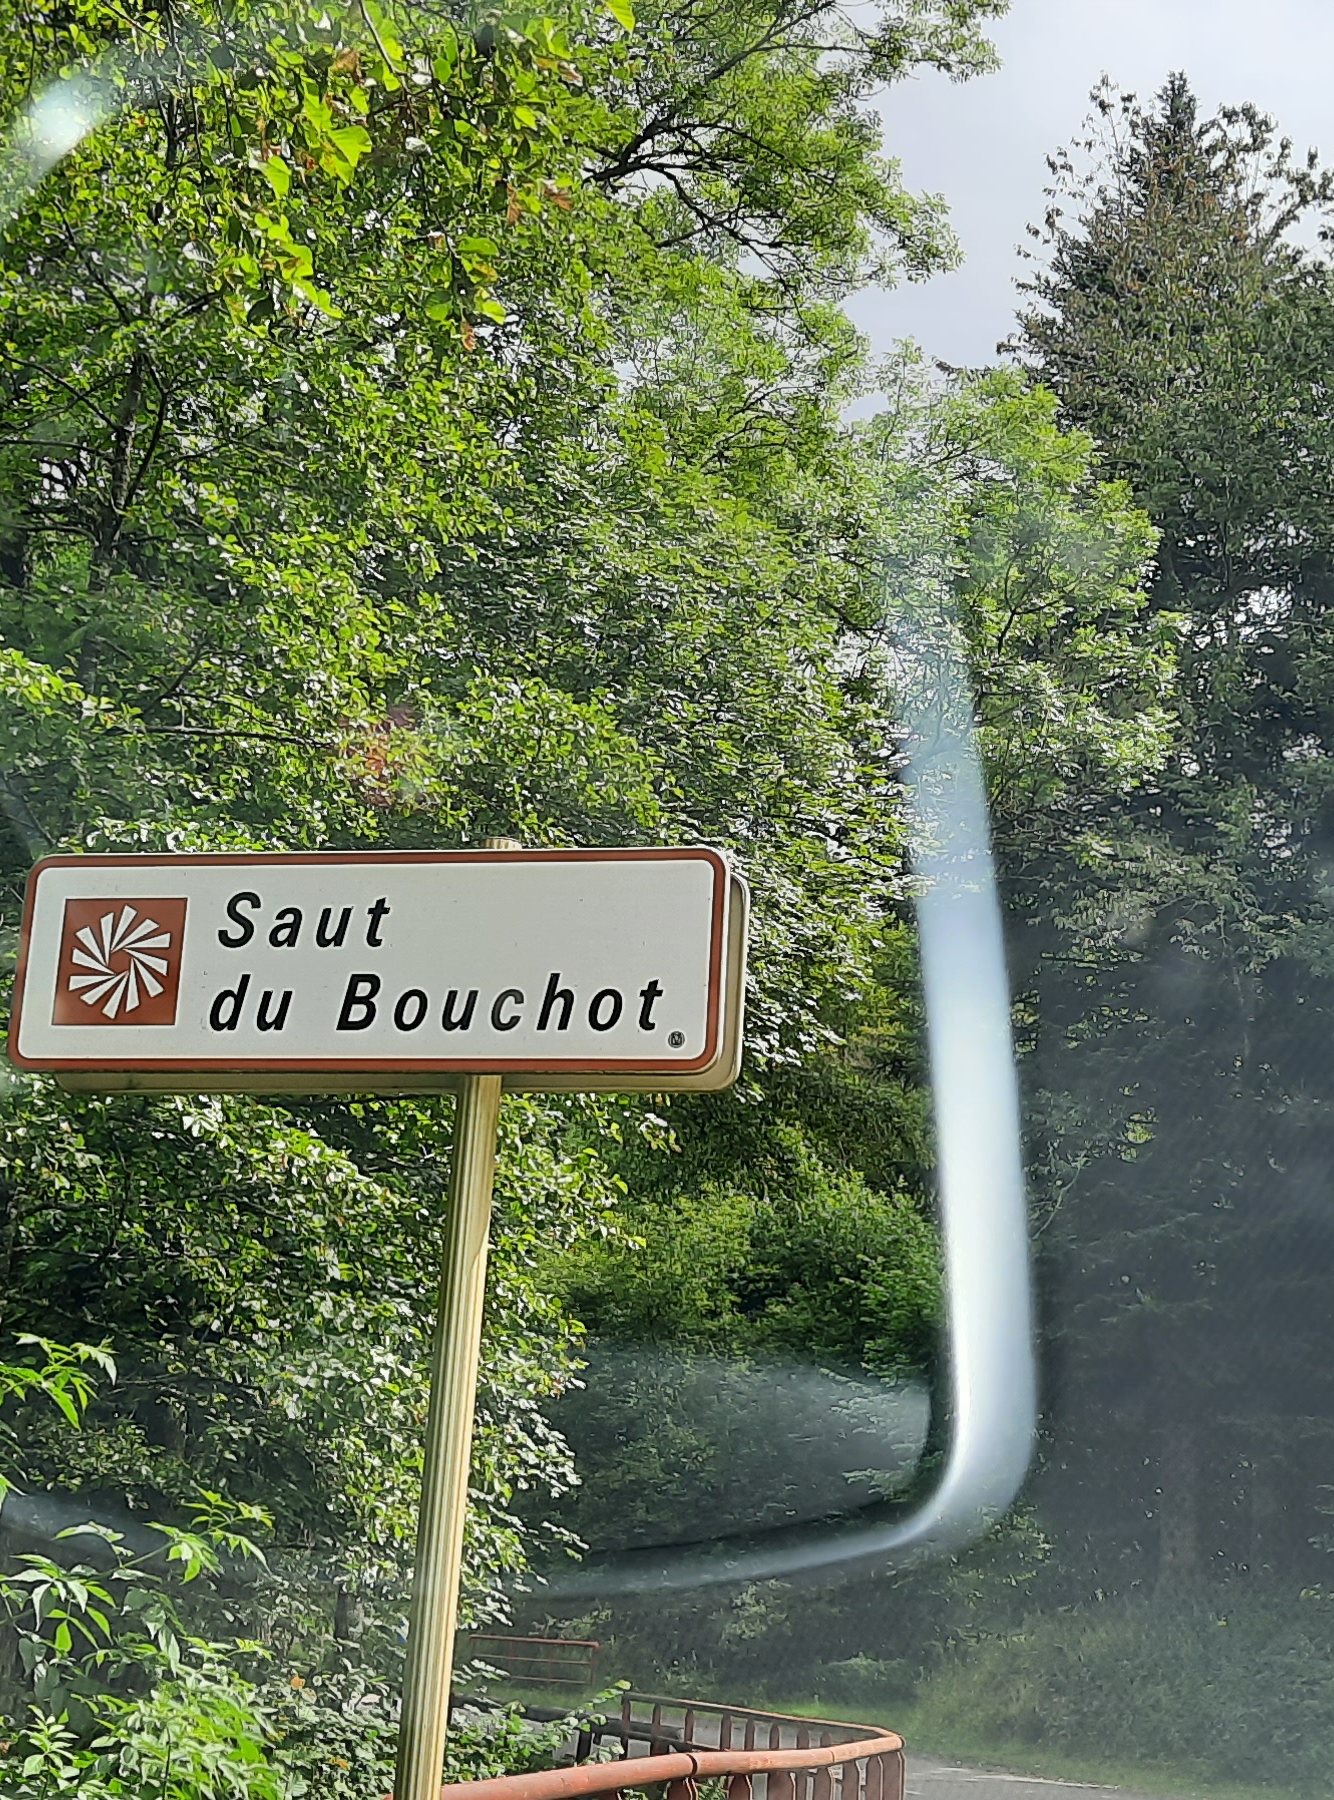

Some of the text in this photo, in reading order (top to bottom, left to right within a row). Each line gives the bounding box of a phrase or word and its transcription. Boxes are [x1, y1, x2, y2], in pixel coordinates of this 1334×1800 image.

[217, 891, 391, 949] Saut
[208, 972, 664, 1032] du Bouchot
